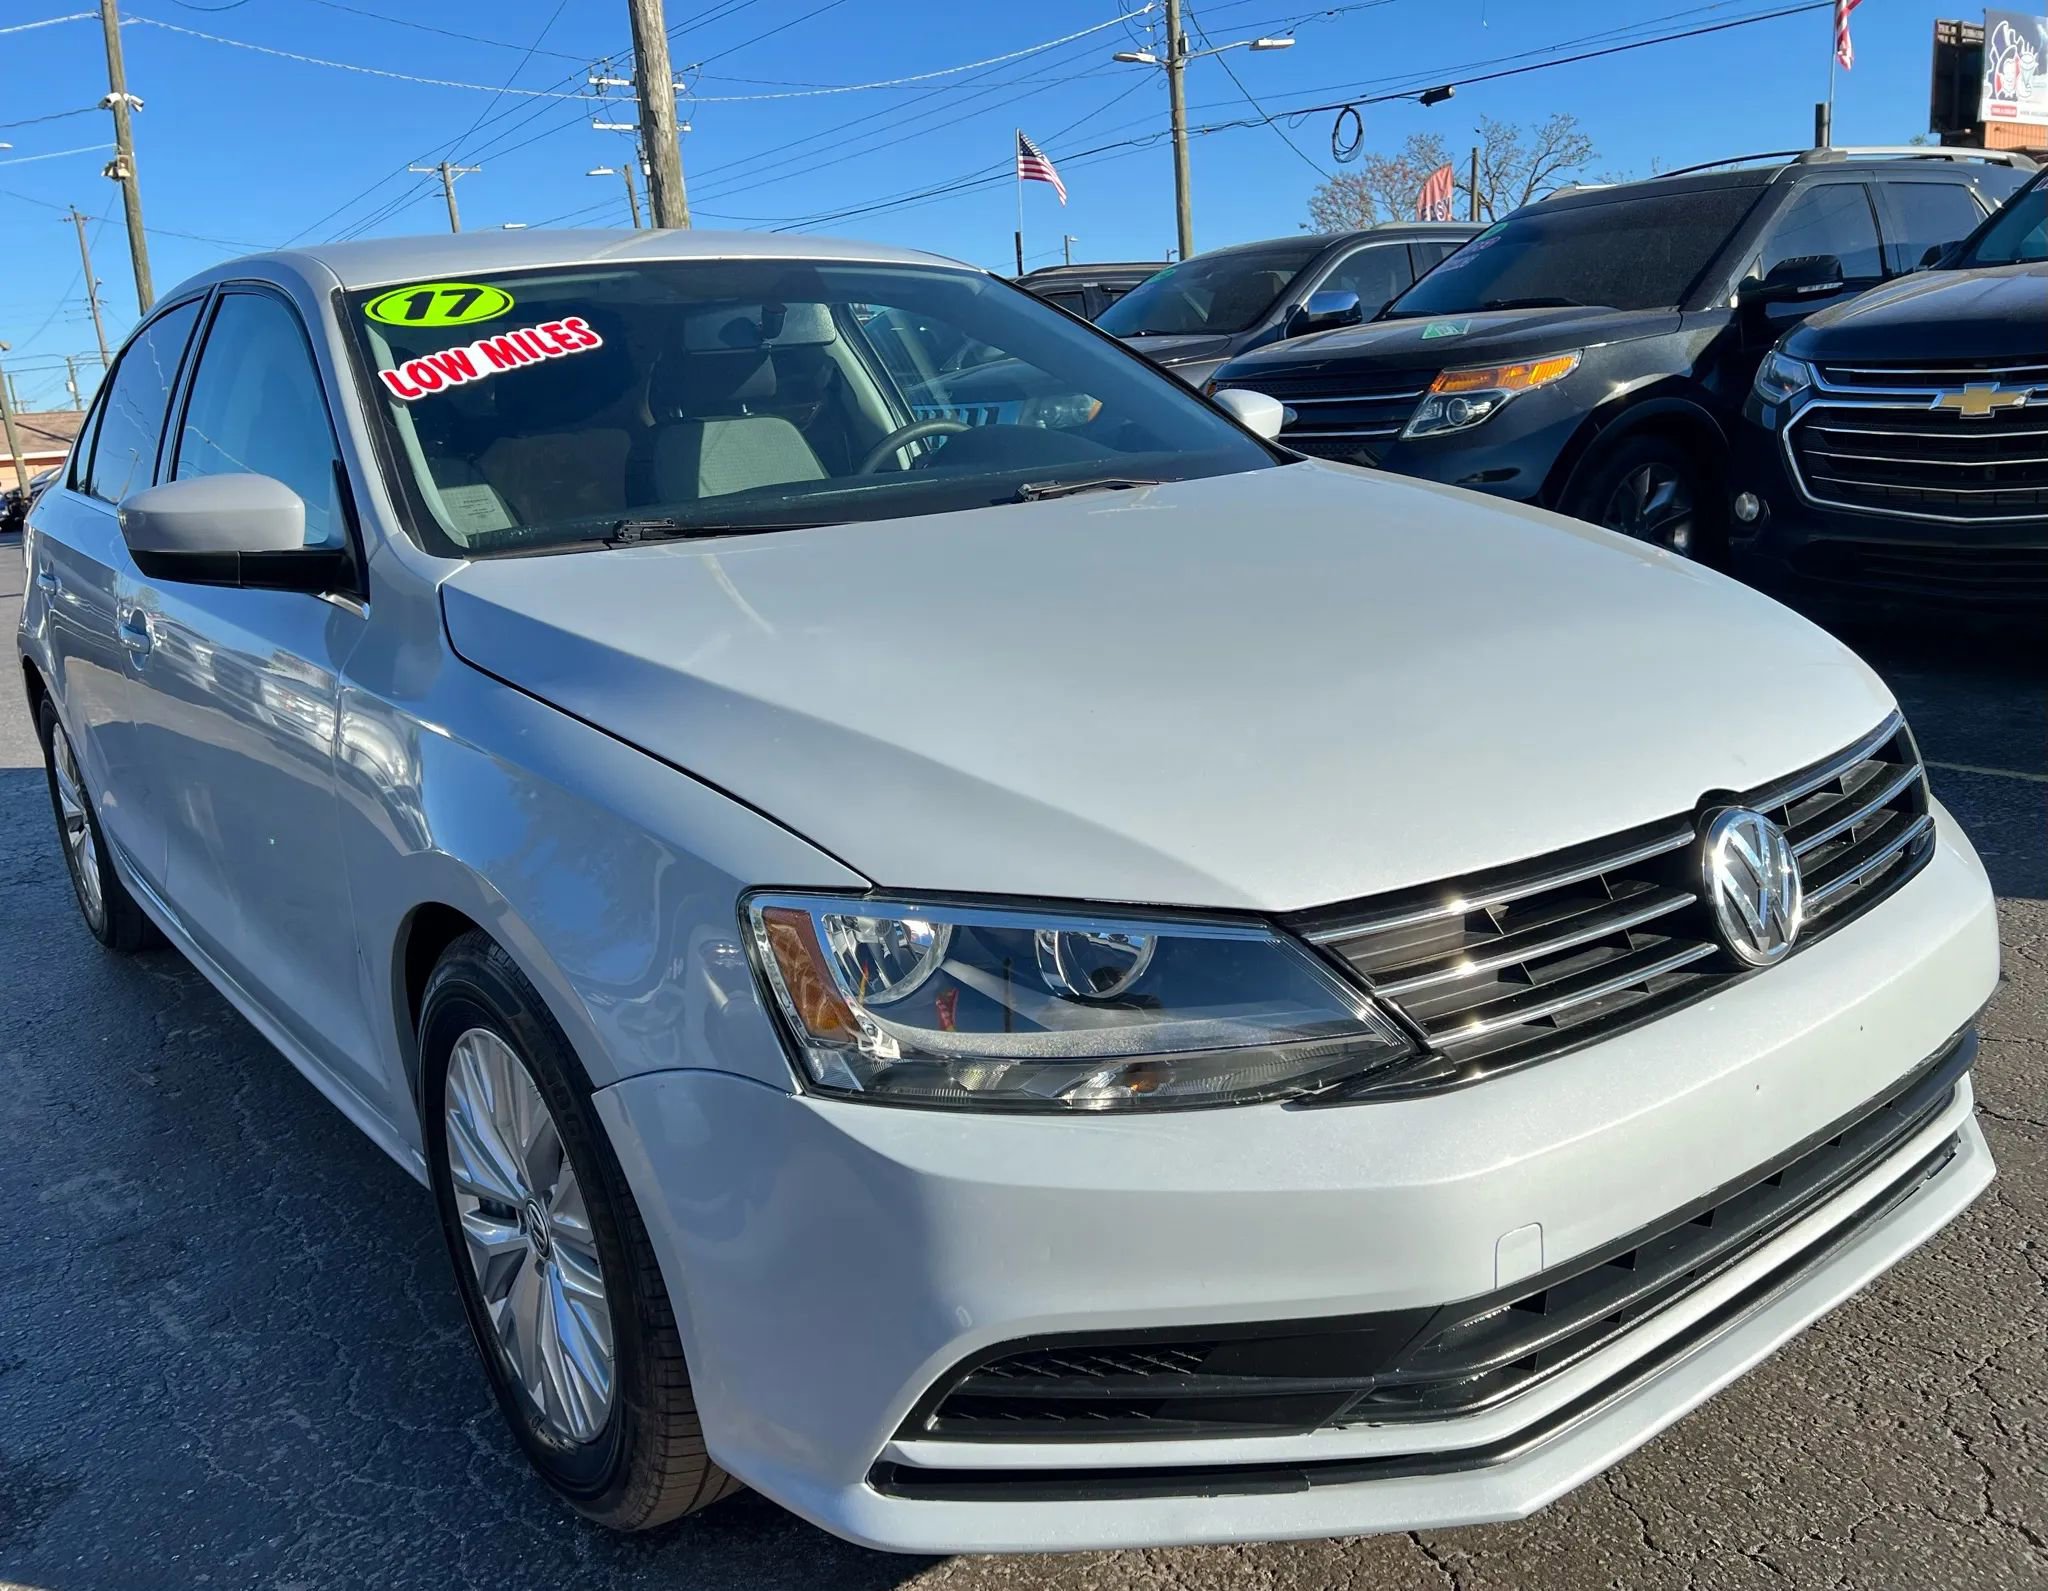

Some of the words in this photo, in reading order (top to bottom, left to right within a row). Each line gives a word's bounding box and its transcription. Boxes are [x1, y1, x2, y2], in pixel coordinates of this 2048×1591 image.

[403, 288, 484, 321] 17
[383, 349, 478, 397] LOW
[479, 319, 598, 369] MILES
